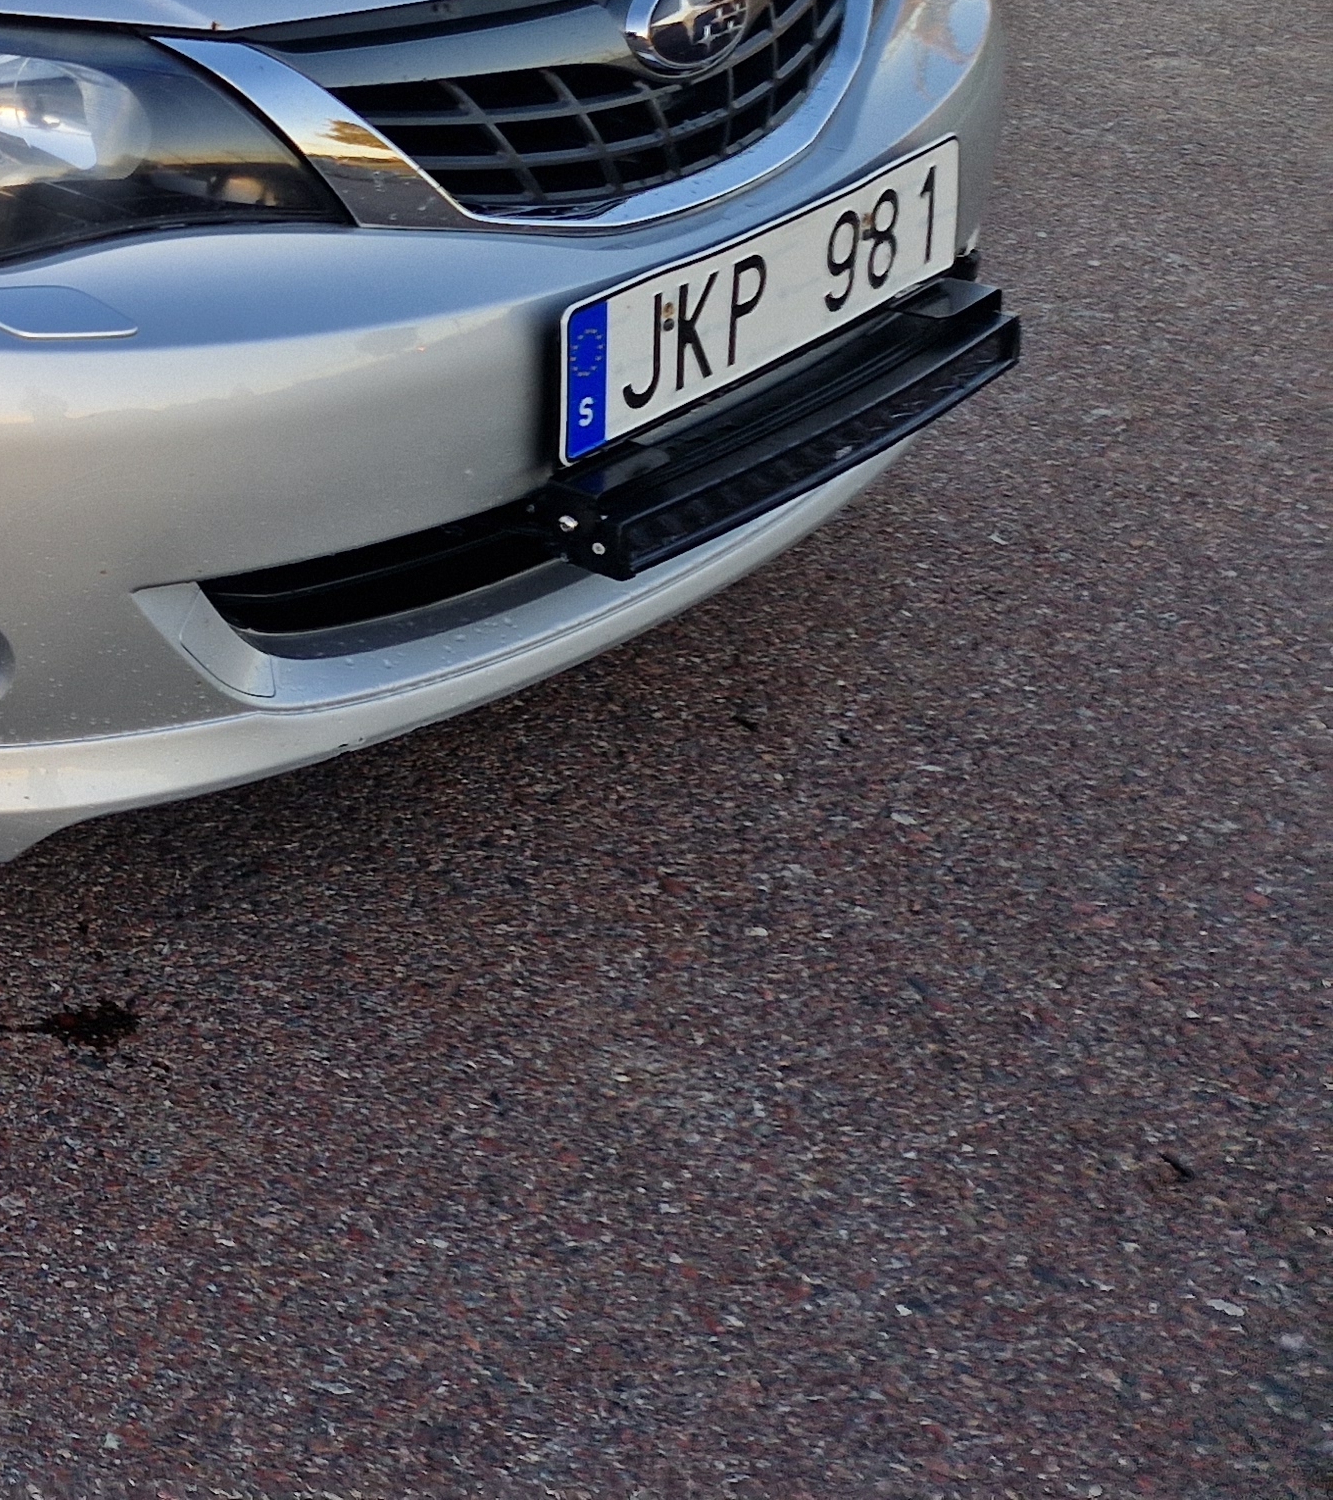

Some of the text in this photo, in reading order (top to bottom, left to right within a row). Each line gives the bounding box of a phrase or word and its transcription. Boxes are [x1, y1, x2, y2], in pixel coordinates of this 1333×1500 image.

[622, 165, 937, 409] JKP 981
[578, 396, 594, 427] S
